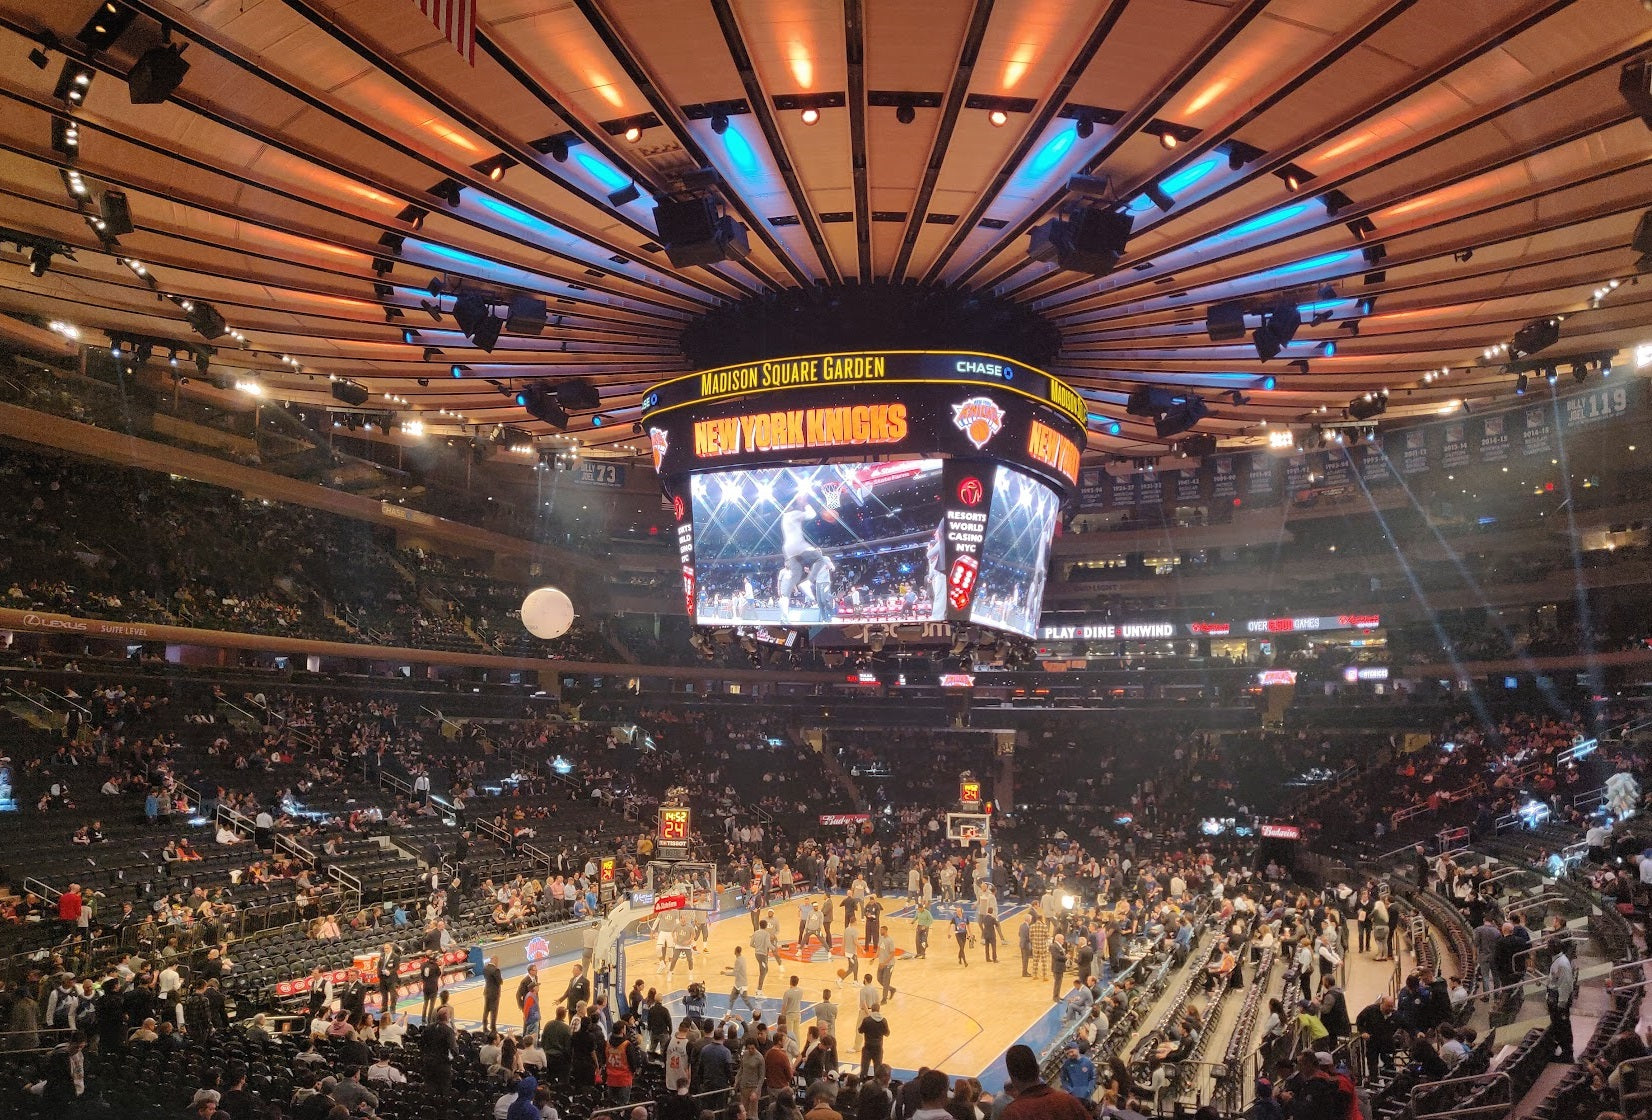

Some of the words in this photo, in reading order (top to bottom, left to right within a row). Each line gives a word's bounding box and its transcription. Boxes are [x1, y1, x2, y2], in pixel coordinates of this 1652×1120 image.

[701, 367, 758, 397] MADISON
[762, 361, 818, 387] SQUARE
[823, 356, 885, 381] GARDEN
[956, 361, 1002, 377] CHASE
[1589, 387, 1627, 418] 119
[694, 417, 741, 458] NEW
[739, 409, 805, 453] YORK
[806, 403, 908, 447] KNICKS
[1027, 420, 1060, 468] NEW
[596, 464, 616, 483] 73
[947, 510, 987, 523] RESORTS
[949, 521, 984, 532] WORLD
[948, 532, 983, 543] CASINO
[956, 543, 976, 553] NYC
[41, 618, 87, 631] LEXUS
[100, 624, 123, 634] SUITE
[125, 626, 148, 637] LEVEL
[1045, 627, 1076, 639] PLAY
[1083, 626, 1115, 639] DINE
[1122, 624, 1174, 638] UNWIND
[1248, 620, 1268, 632] OVER
[1293, 617, 1320, 629] GAMES
[964, 790, 977, 800] 24
[665, 811, 687, 823] 14:52
[664, 821, 684, 838] 24
